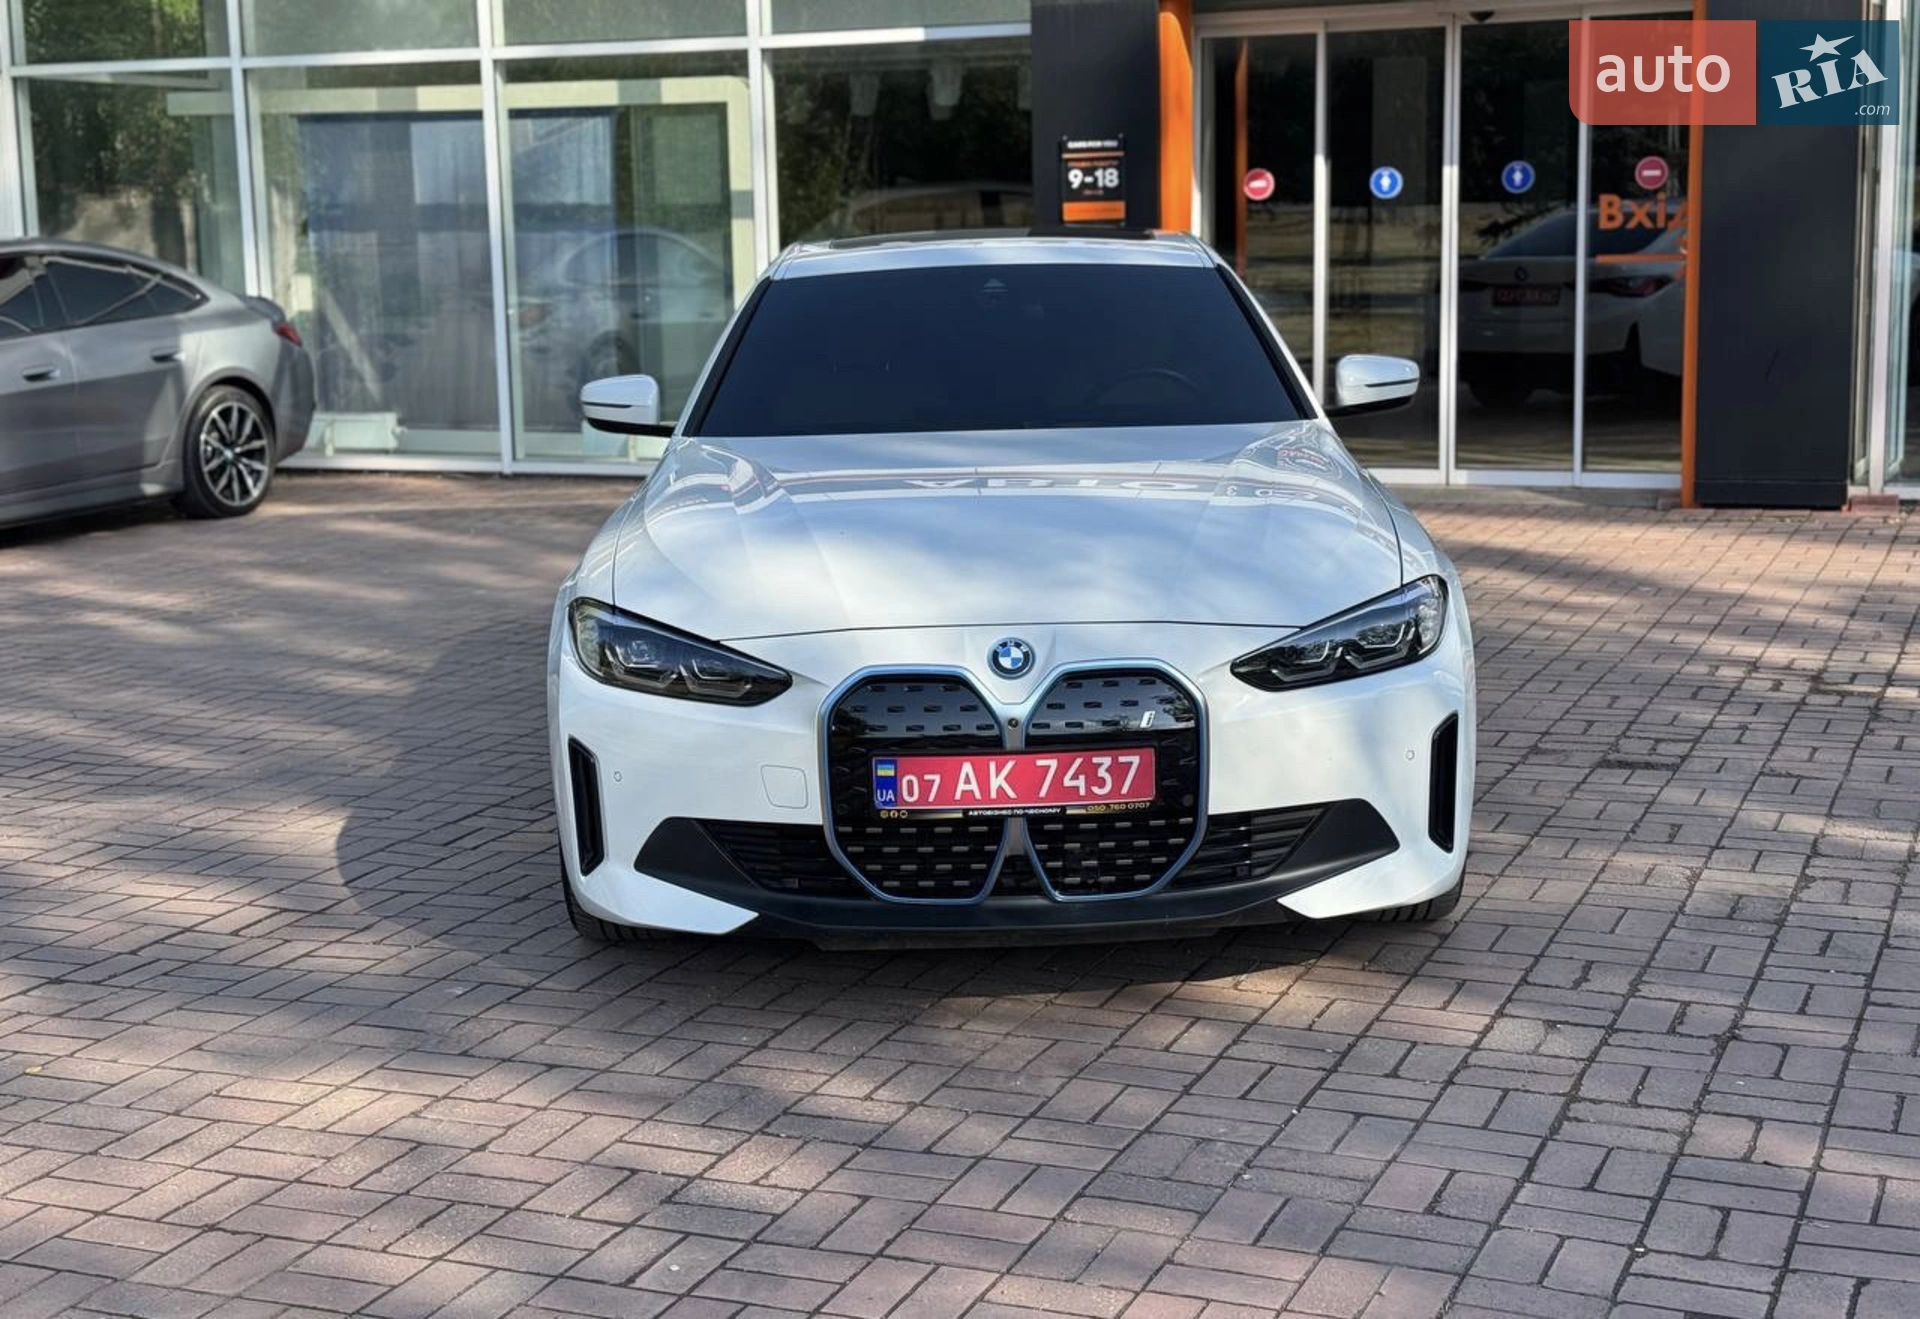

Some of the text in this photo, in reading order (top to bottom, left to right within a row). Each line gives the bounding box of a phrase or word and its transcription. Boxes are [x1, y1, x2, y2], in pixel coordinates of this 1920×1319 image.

[1067, 167, 1120, 189] 9-18
[901, 773, 941, 803] 07
[1035, 755, 1141, 798] 7437
[876, 789, 895, 802] UA
